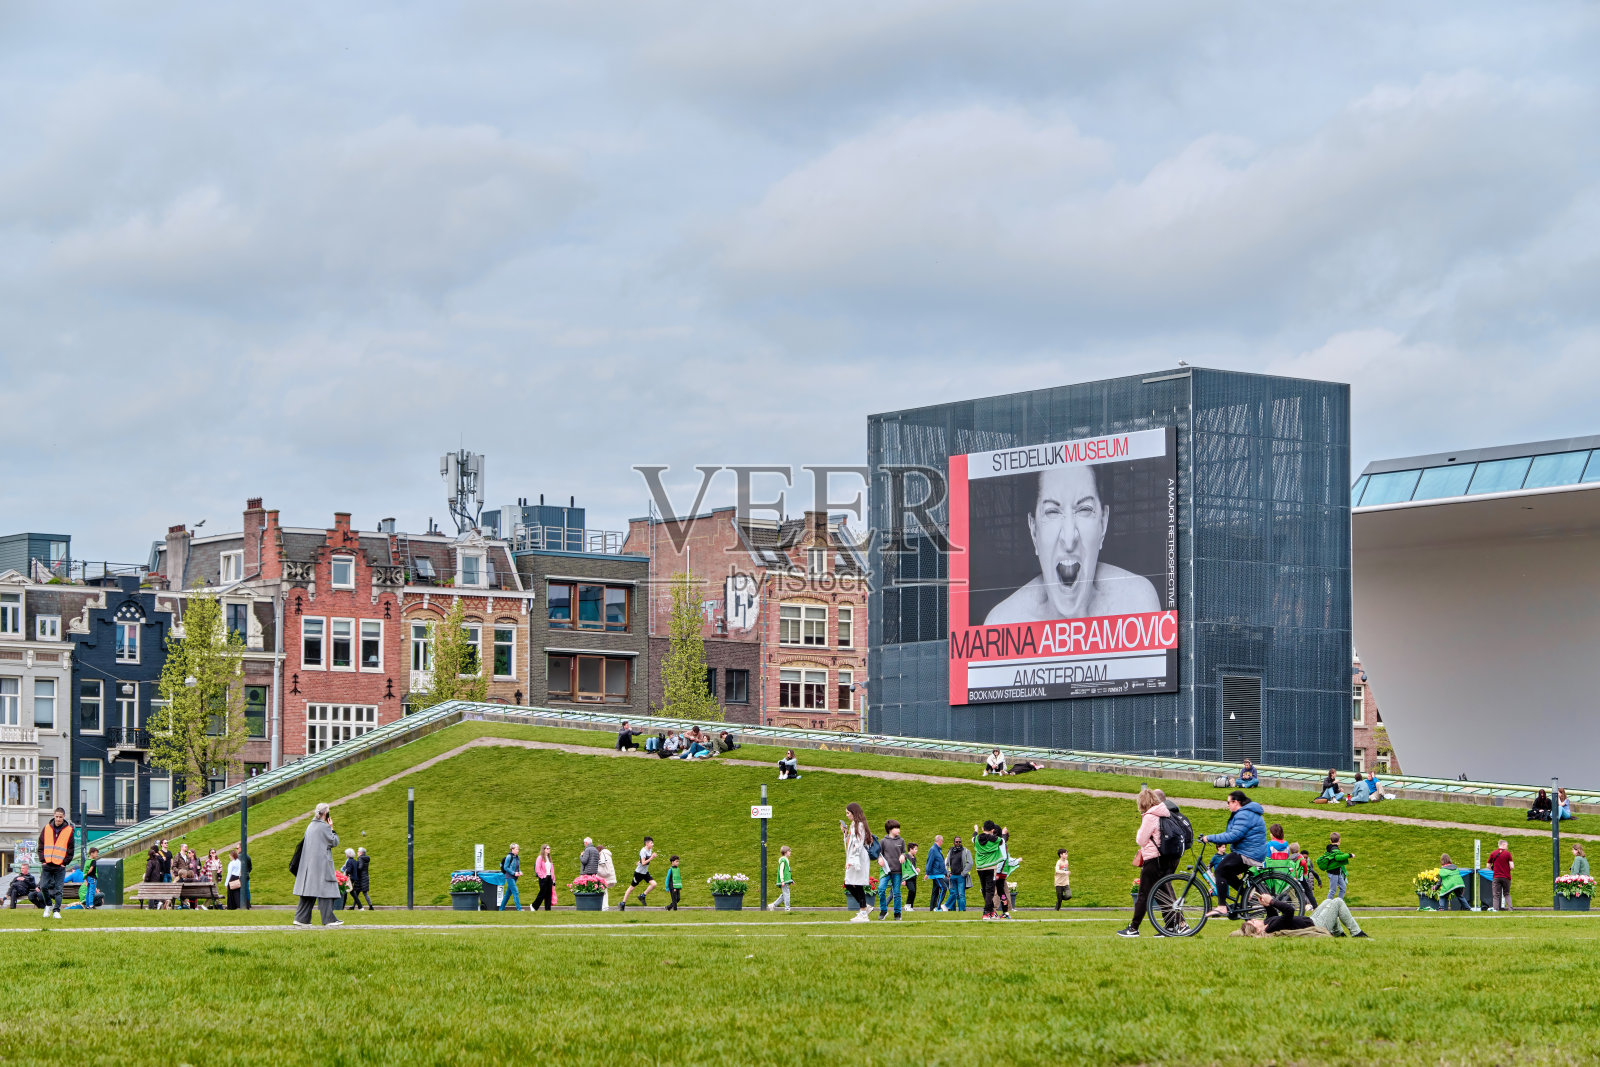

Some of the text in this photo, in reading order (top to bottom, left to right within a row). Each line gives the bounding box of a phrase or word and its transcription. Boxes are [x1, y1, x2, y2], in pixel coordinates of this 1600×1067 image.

[1167, 478, 1175, 608] A MAJOR RETROSPECTIVE
[951, 611, 1176, 660] MARINA ABRAMOVIĆ
[1013, 664, 1108, 686] AMSTERDAM
